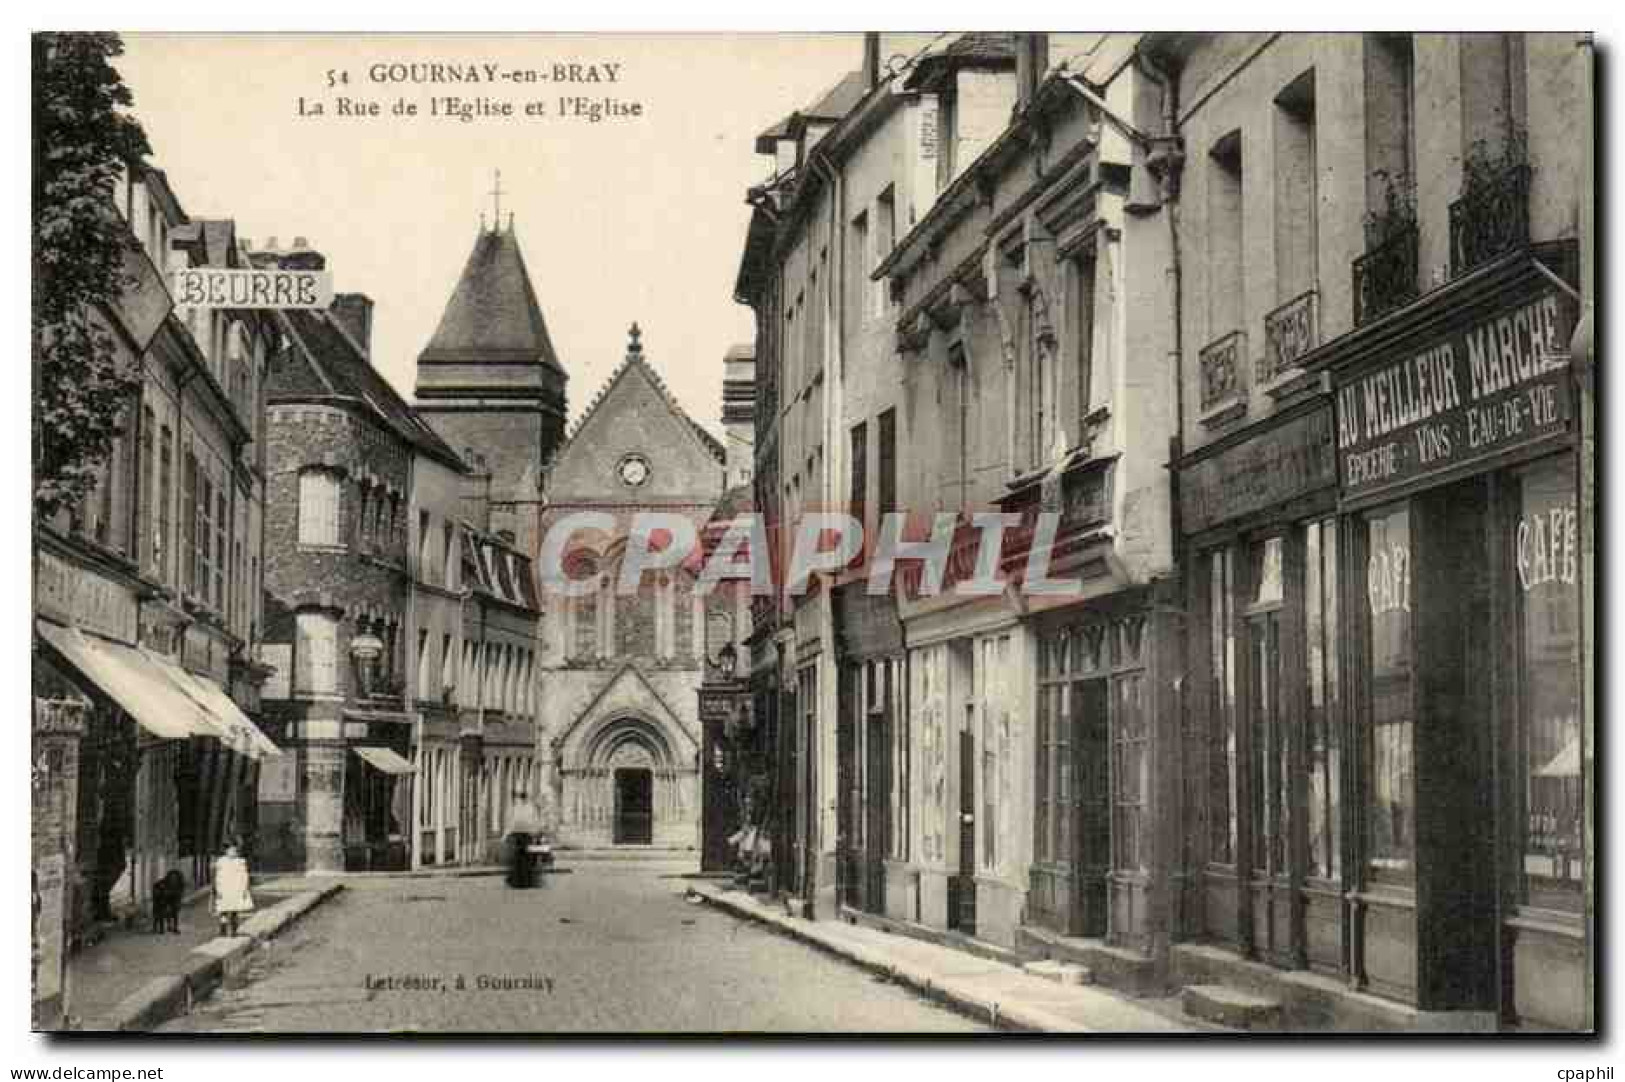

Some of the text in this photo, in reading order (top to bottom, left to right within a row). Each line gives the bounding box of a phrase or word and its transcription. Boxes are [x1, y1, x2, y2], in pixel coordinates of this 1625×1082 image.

[178, 272, 318, 305] BEURRE
[1338, 384, 1359, 450] AU
[1362, 343, 1461, 441] MEILLEUR
[1415, 423, 1451, 463] VINS
